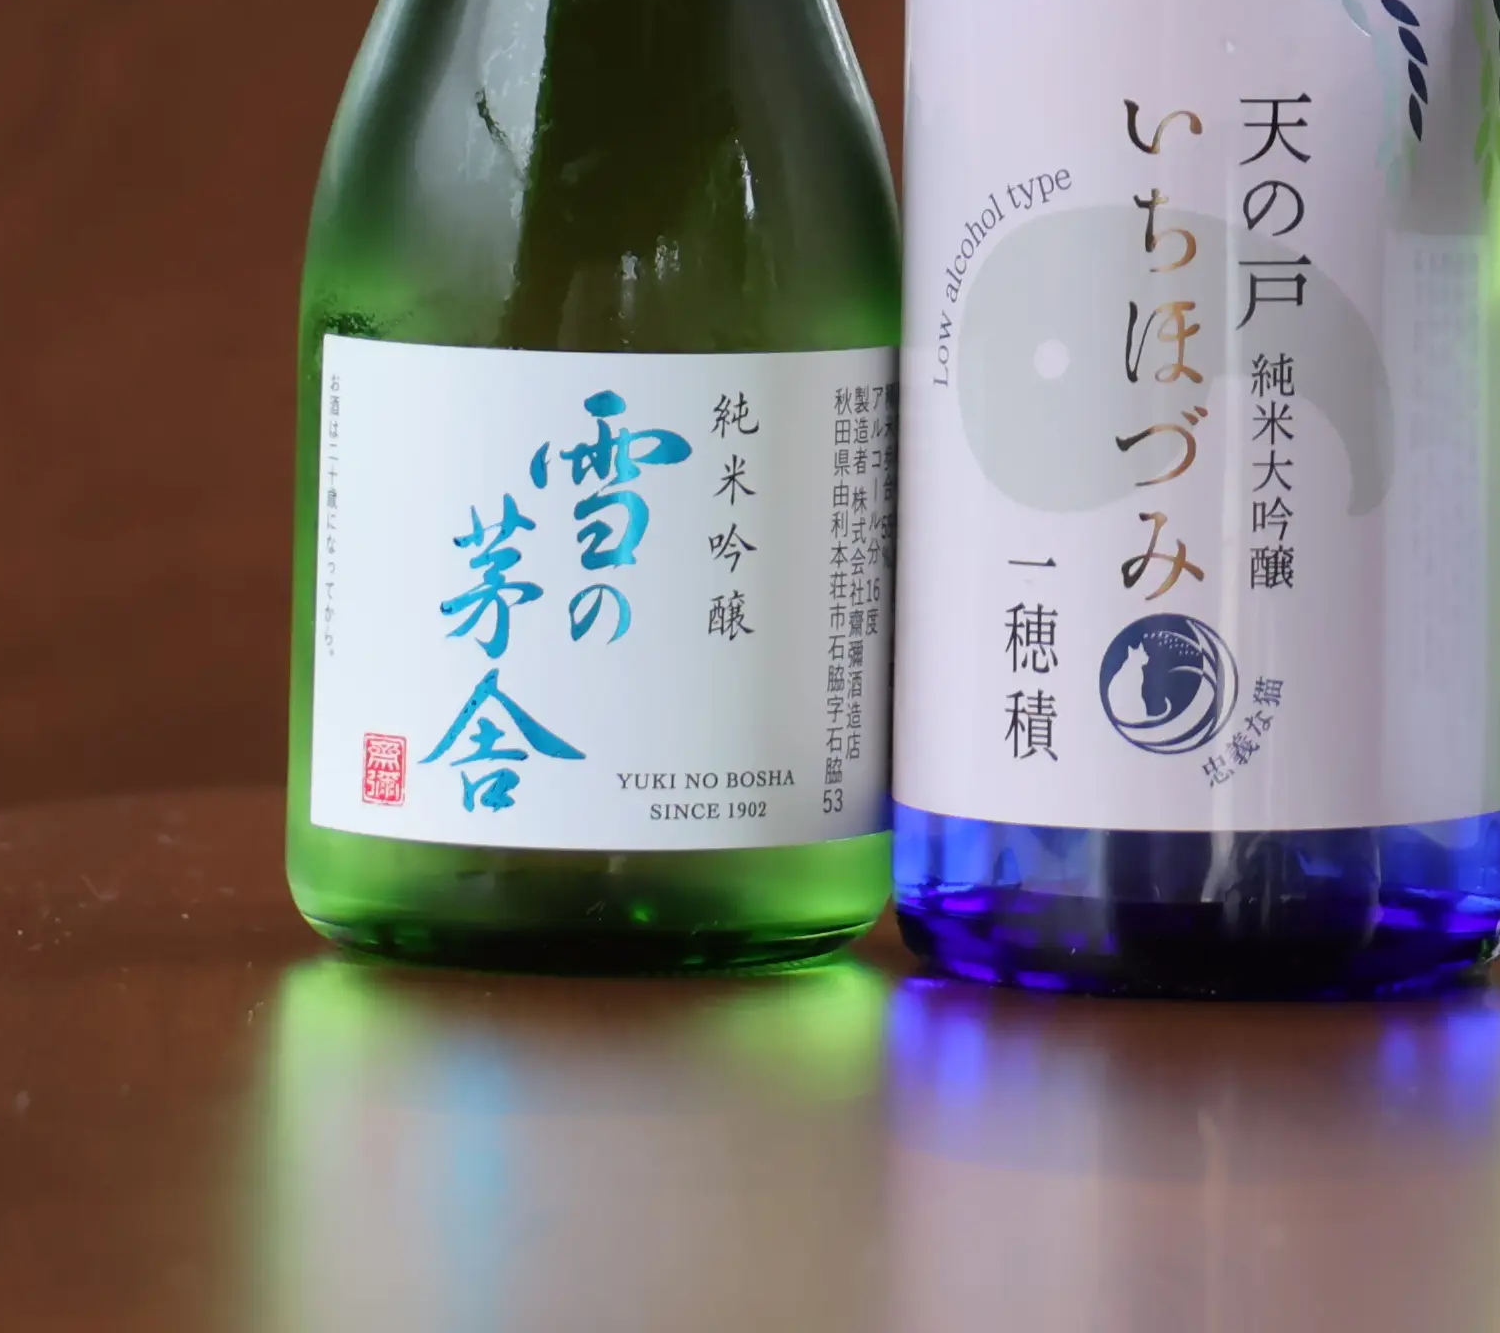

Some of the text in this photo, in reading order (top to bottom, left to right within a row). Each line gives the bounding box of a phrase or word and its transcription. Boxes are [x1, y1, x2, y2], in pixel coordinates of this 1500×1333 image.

[932, 167, 1073, 388] Low alcohol type
[1115, 96, 1209, 602] いちほづみ
[1236, 92, 1313, 591] 天の戸 純米大吟醸
[706, 391, 760, 642] 純米吟醸
[852, 385, 870, 475] 製造者
[864, 386, 884, 637] アルコール分 16度
[417, 389, 693, 813] 雪の 茅舎
[1003, 558, 1060, 763] 一穂積
[616, 769, 796, 791] YUKI NO BOSHA
[650, 801, 768, 820] SINCE 1902
[1201, 675, 1285, 788] 忠義な猫
